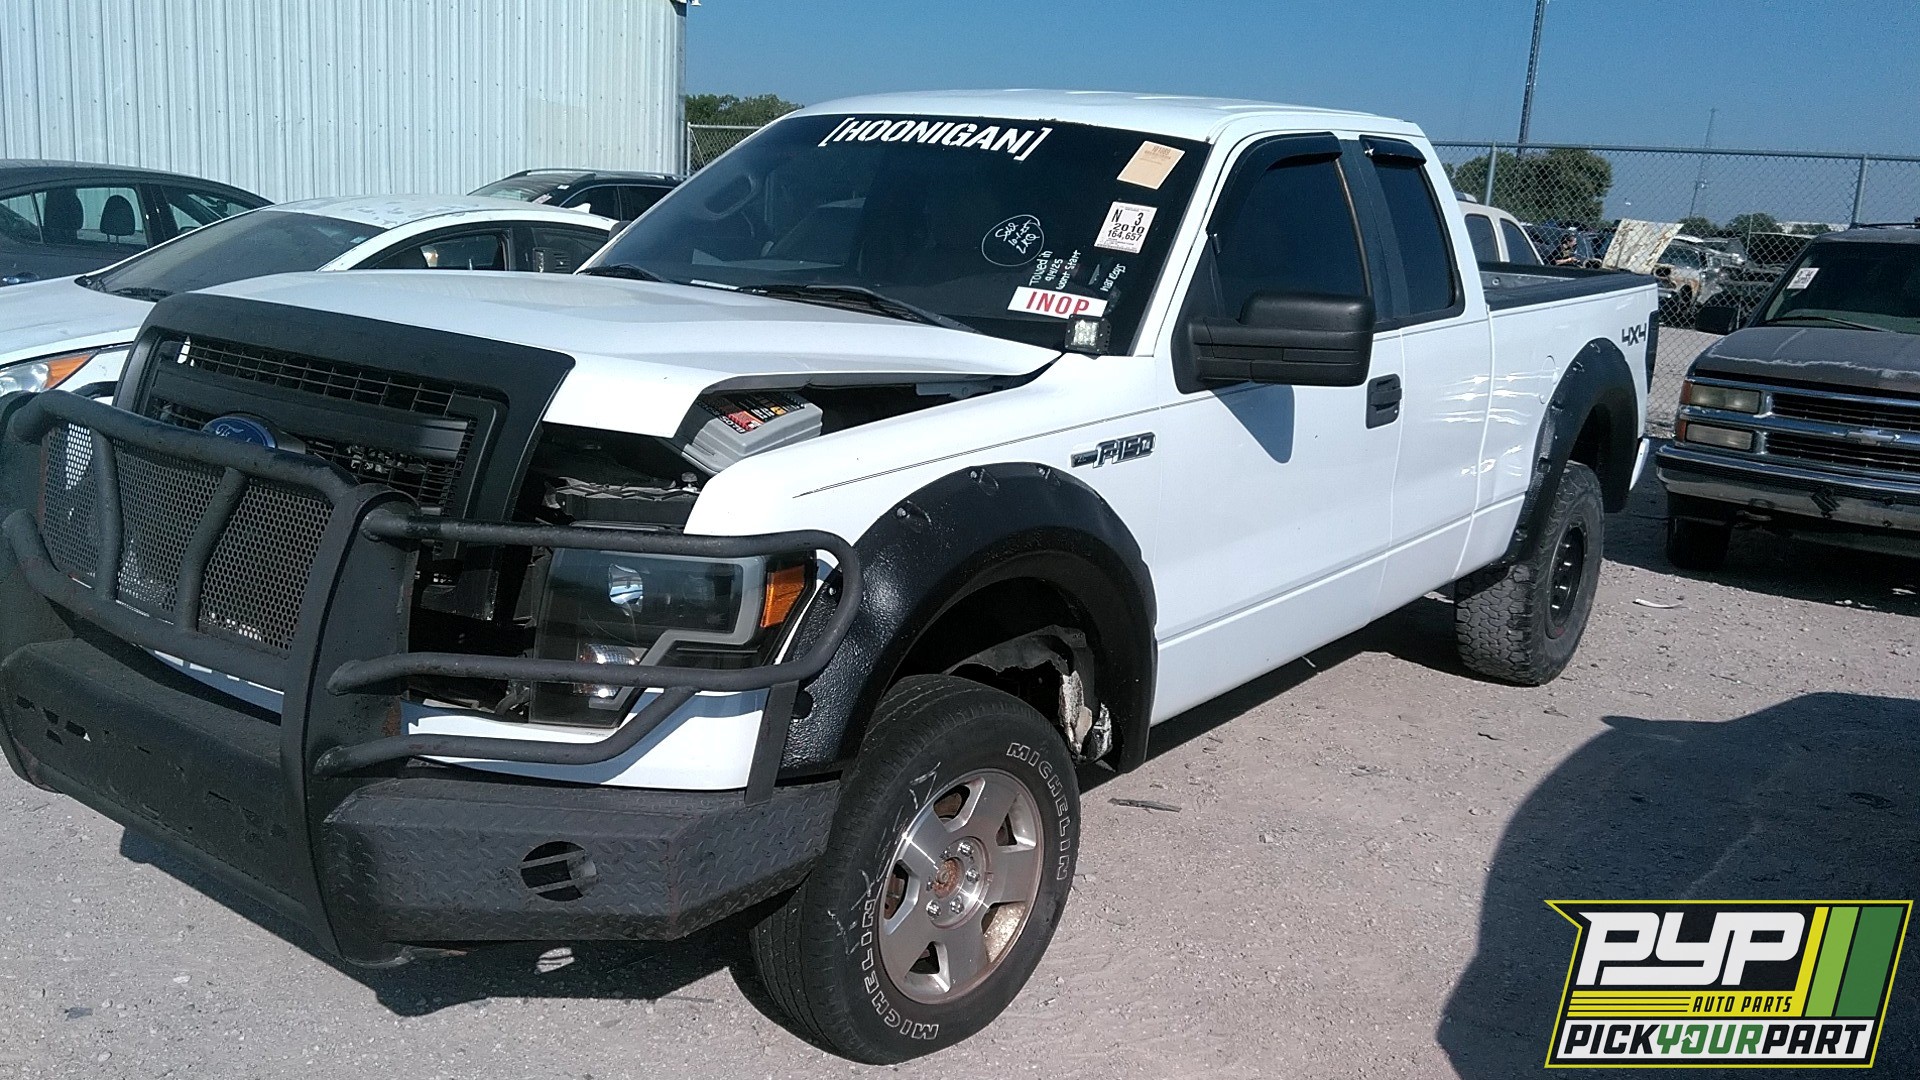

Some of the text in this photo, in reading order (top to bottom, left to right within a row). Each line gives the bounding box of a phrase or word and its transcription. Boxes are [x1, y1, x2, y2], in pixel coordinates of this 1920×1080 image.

[1111, 209, 1144, 226] N 3
[1107, 230, 1142, 241] 164,657
[1113, 223, 1145, 234] 2010
[1026, 291, 1090, 315] INOP
[1006, 742, 1072, 881] MICHELIN
[860, 898, 940, 1041] MICHELIN
